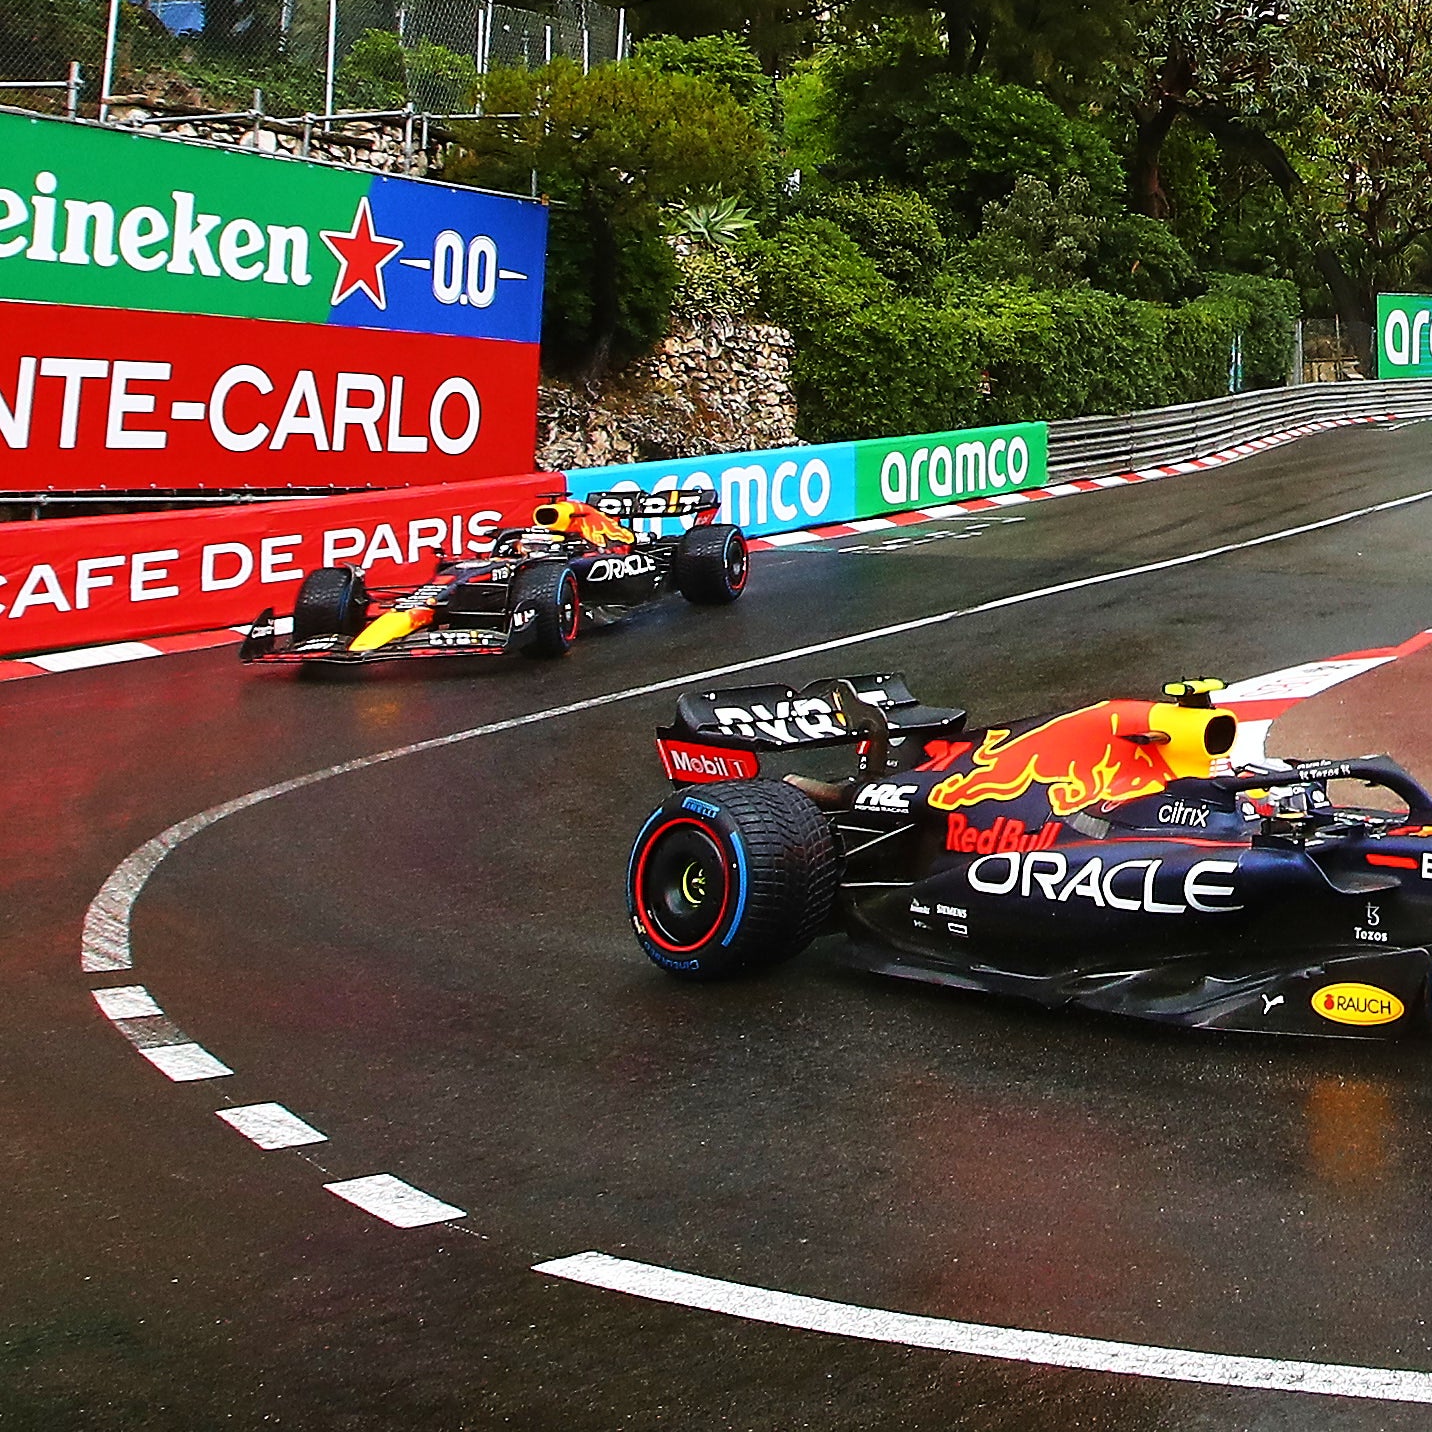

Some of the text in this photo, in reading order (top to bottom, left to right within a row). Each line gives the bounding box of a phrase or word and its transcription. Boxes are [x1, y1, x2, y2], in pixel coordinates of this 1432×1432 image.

[880, 435, 1029, 505] aramco
[0, 510, 503, 619] AFE DE PARIS
[587, 552, 657, 582] ORACLE
[669, 749, 745, 778] Mobil 1
[855, 783, 919, 807] HRC
[1158, 798, 1210, 829] citrix
[967, 851, 1245, 914] ORACLE
[1337, 994, 1392, 1016] RAUCH
